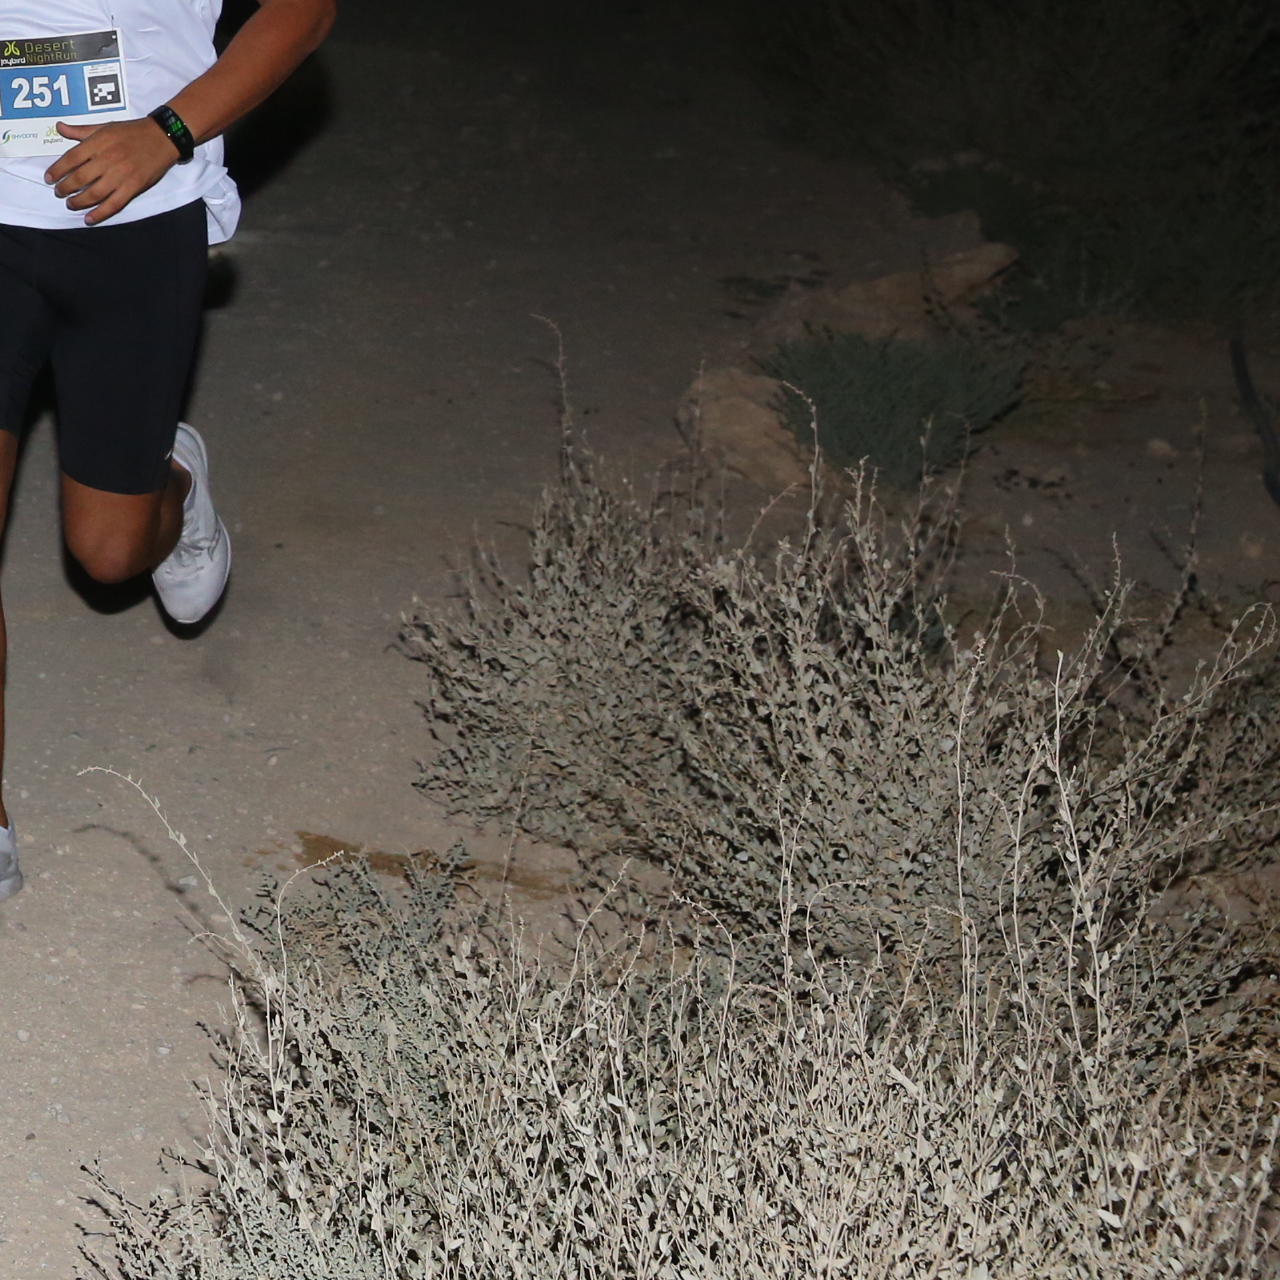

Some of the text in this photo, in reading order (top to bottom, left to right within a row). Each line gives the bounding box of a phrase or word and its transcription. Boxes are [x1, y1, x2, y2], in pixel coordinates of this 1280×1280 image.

[24, 39, 75, 53] Desert
[26, 51, 77, 65] NightRun
[11, 74, 70, 110] 251
